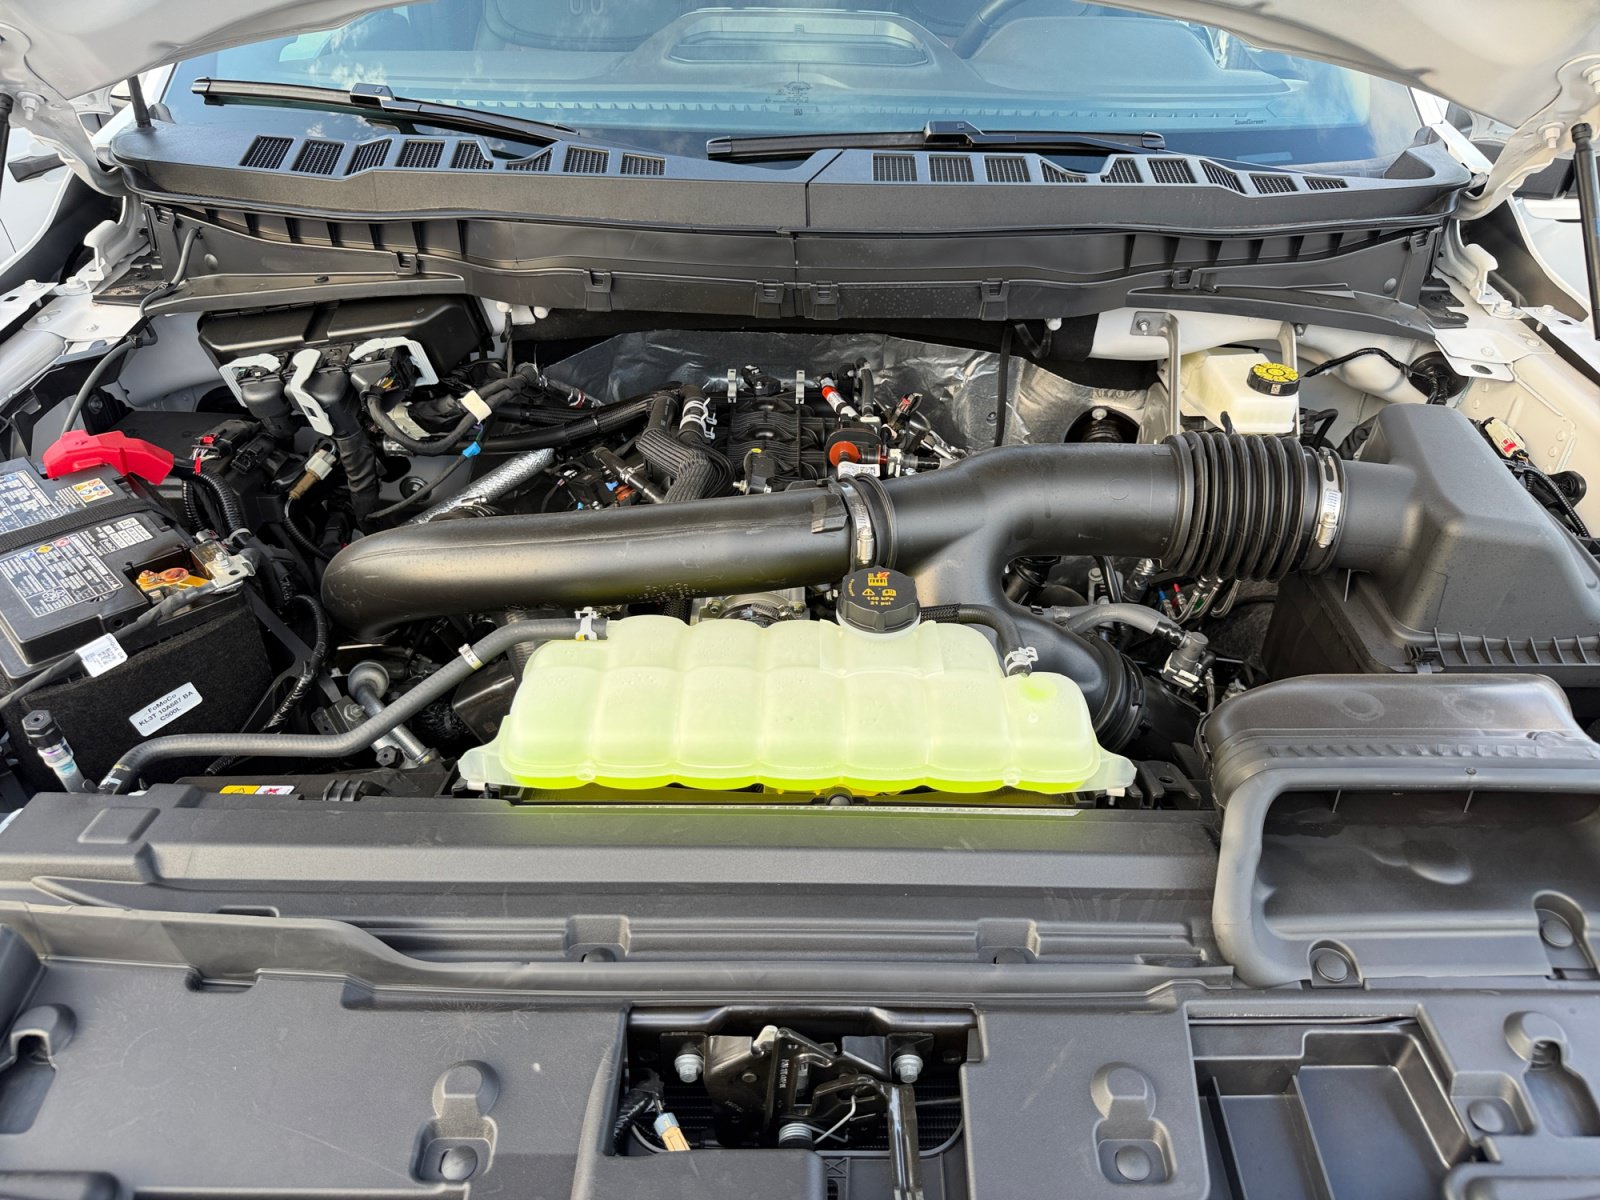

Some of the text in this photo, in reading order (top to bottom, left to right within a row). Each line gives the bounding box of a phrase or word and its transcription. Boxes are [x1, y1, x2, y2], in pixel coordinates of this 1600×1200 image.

[138, 713, 157, 727] KL3T
[182, 691, 193, 699] BA
[147, 694, 176, 713] FoMoCo
